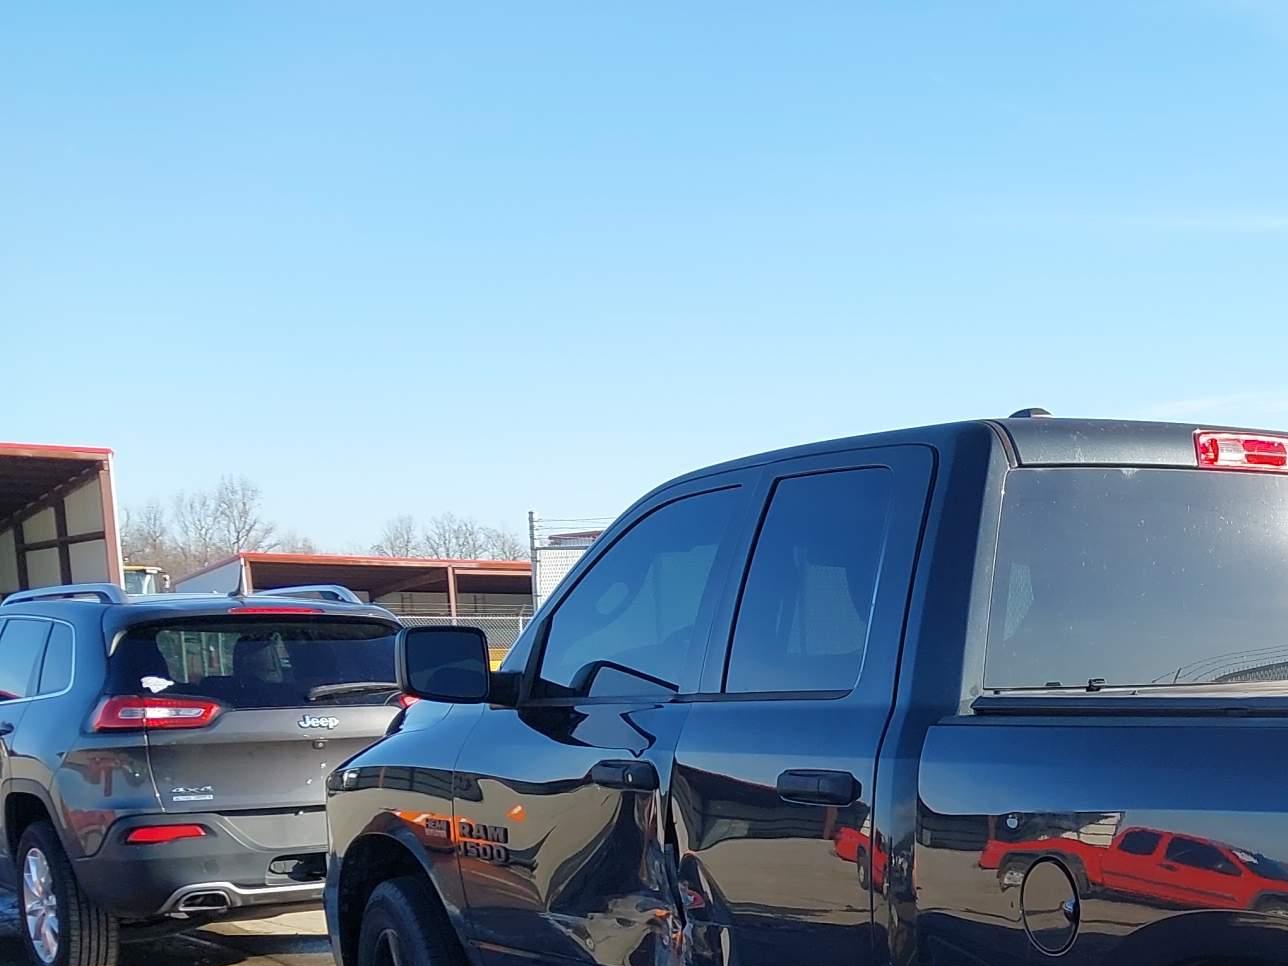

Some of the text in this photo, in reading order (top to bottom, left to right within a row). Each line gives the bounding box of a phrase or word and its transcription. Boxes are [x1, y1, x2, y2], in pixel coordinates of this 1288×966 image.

[298, 714, 340, 730] Jeep
[458, 821, 509, 844] RAM
[456, 841, 510, 864] 1500
